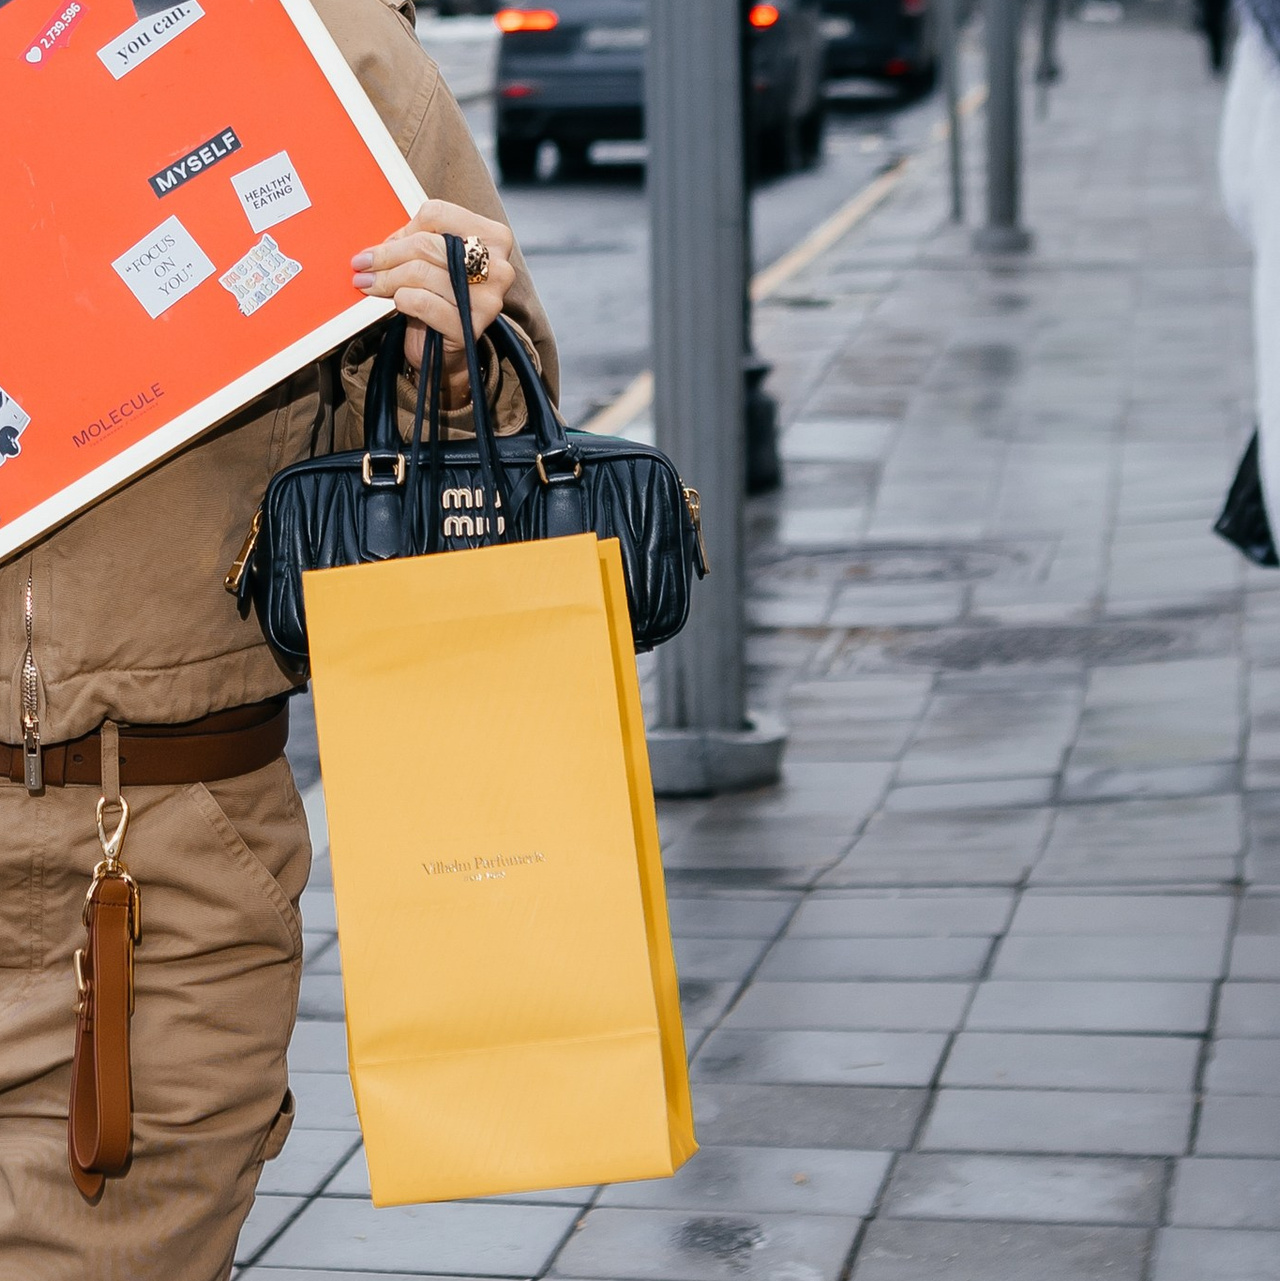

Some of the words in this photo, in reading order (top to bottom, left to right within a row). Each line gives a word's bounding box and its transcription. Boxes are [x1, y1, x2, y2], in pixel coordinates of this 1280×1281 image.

[40, 2, 81, 49] 2,739,596
[116, 32, 151, 64] you
[153, 4, 191, 36] can.
[155, 131, 236, 192] MYSELF
[244, 173, 292, 202] HEALTHY
[253, 185, 293, 209] EATING
[153, 257, 177, 278] ON
[222, 236, 277, 287] mental
[232, 253, 286, 299] health
[242, 261, 300, 315] matters
[72, 382, 165, 448] MOLECULE
[442, 488, 502, 508] mi
